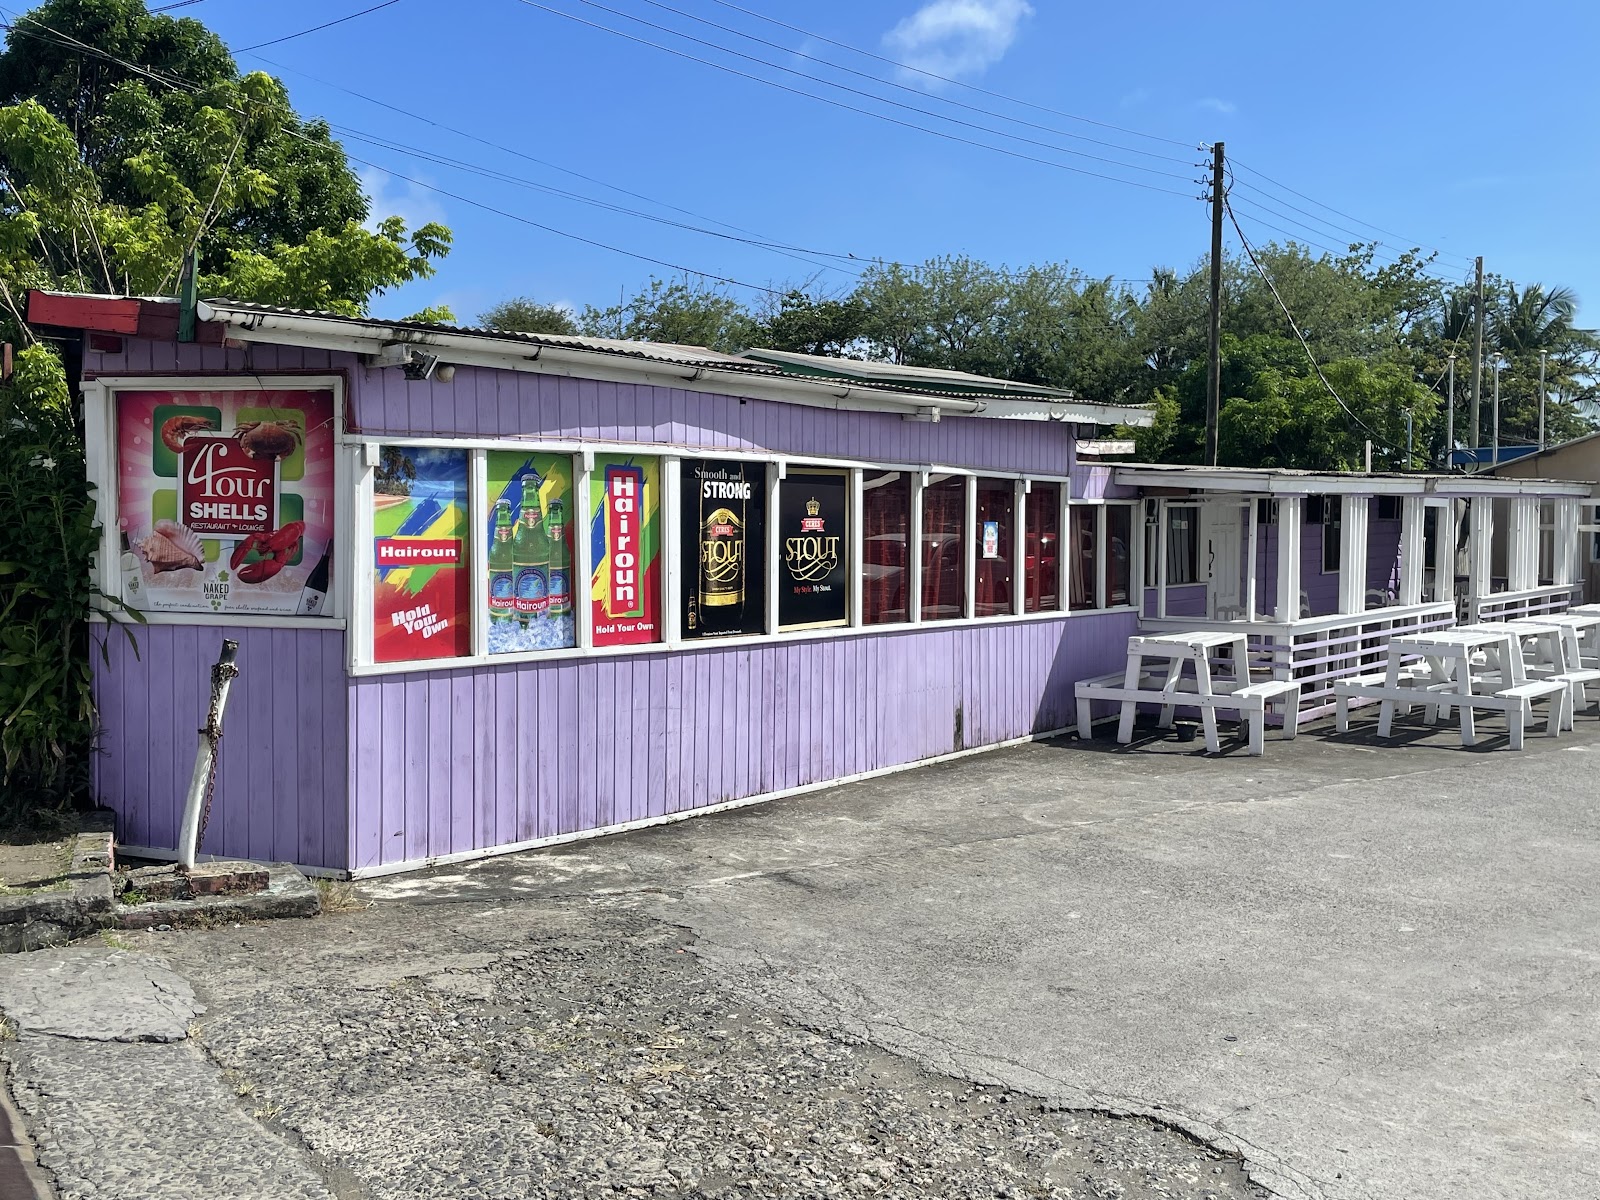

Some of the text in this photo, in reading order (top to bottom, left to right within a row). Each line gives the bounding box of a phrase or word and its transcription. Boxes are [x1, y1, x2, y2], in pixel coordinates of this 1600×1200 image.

[694, 466, 741, 480] Smooth and
[703, 481, 751, 499] STRONG
[190, 502, 268, 521] SHELLS
[190, 522, 231, 530] RESTAURANT
[613, 476, 634, 601] Hairoun
[380, 546, 456, 557] Hairoun
[701, 540, 742, 563] STOUT
[785, 536, 839, 561] STOUT
[203, 582, 229, 594] NAKED
[491, 599, 513, 607] Hairou
[516, 600, 547, 611] Hairoun
[549, 595, 569, 604] airoun
[391, 603, 431, 627] Hold
[403, 613, 437, 635] Your
[422, 618, 449, 639] Own
[595, 621, 654, 635] Hold Your Own
